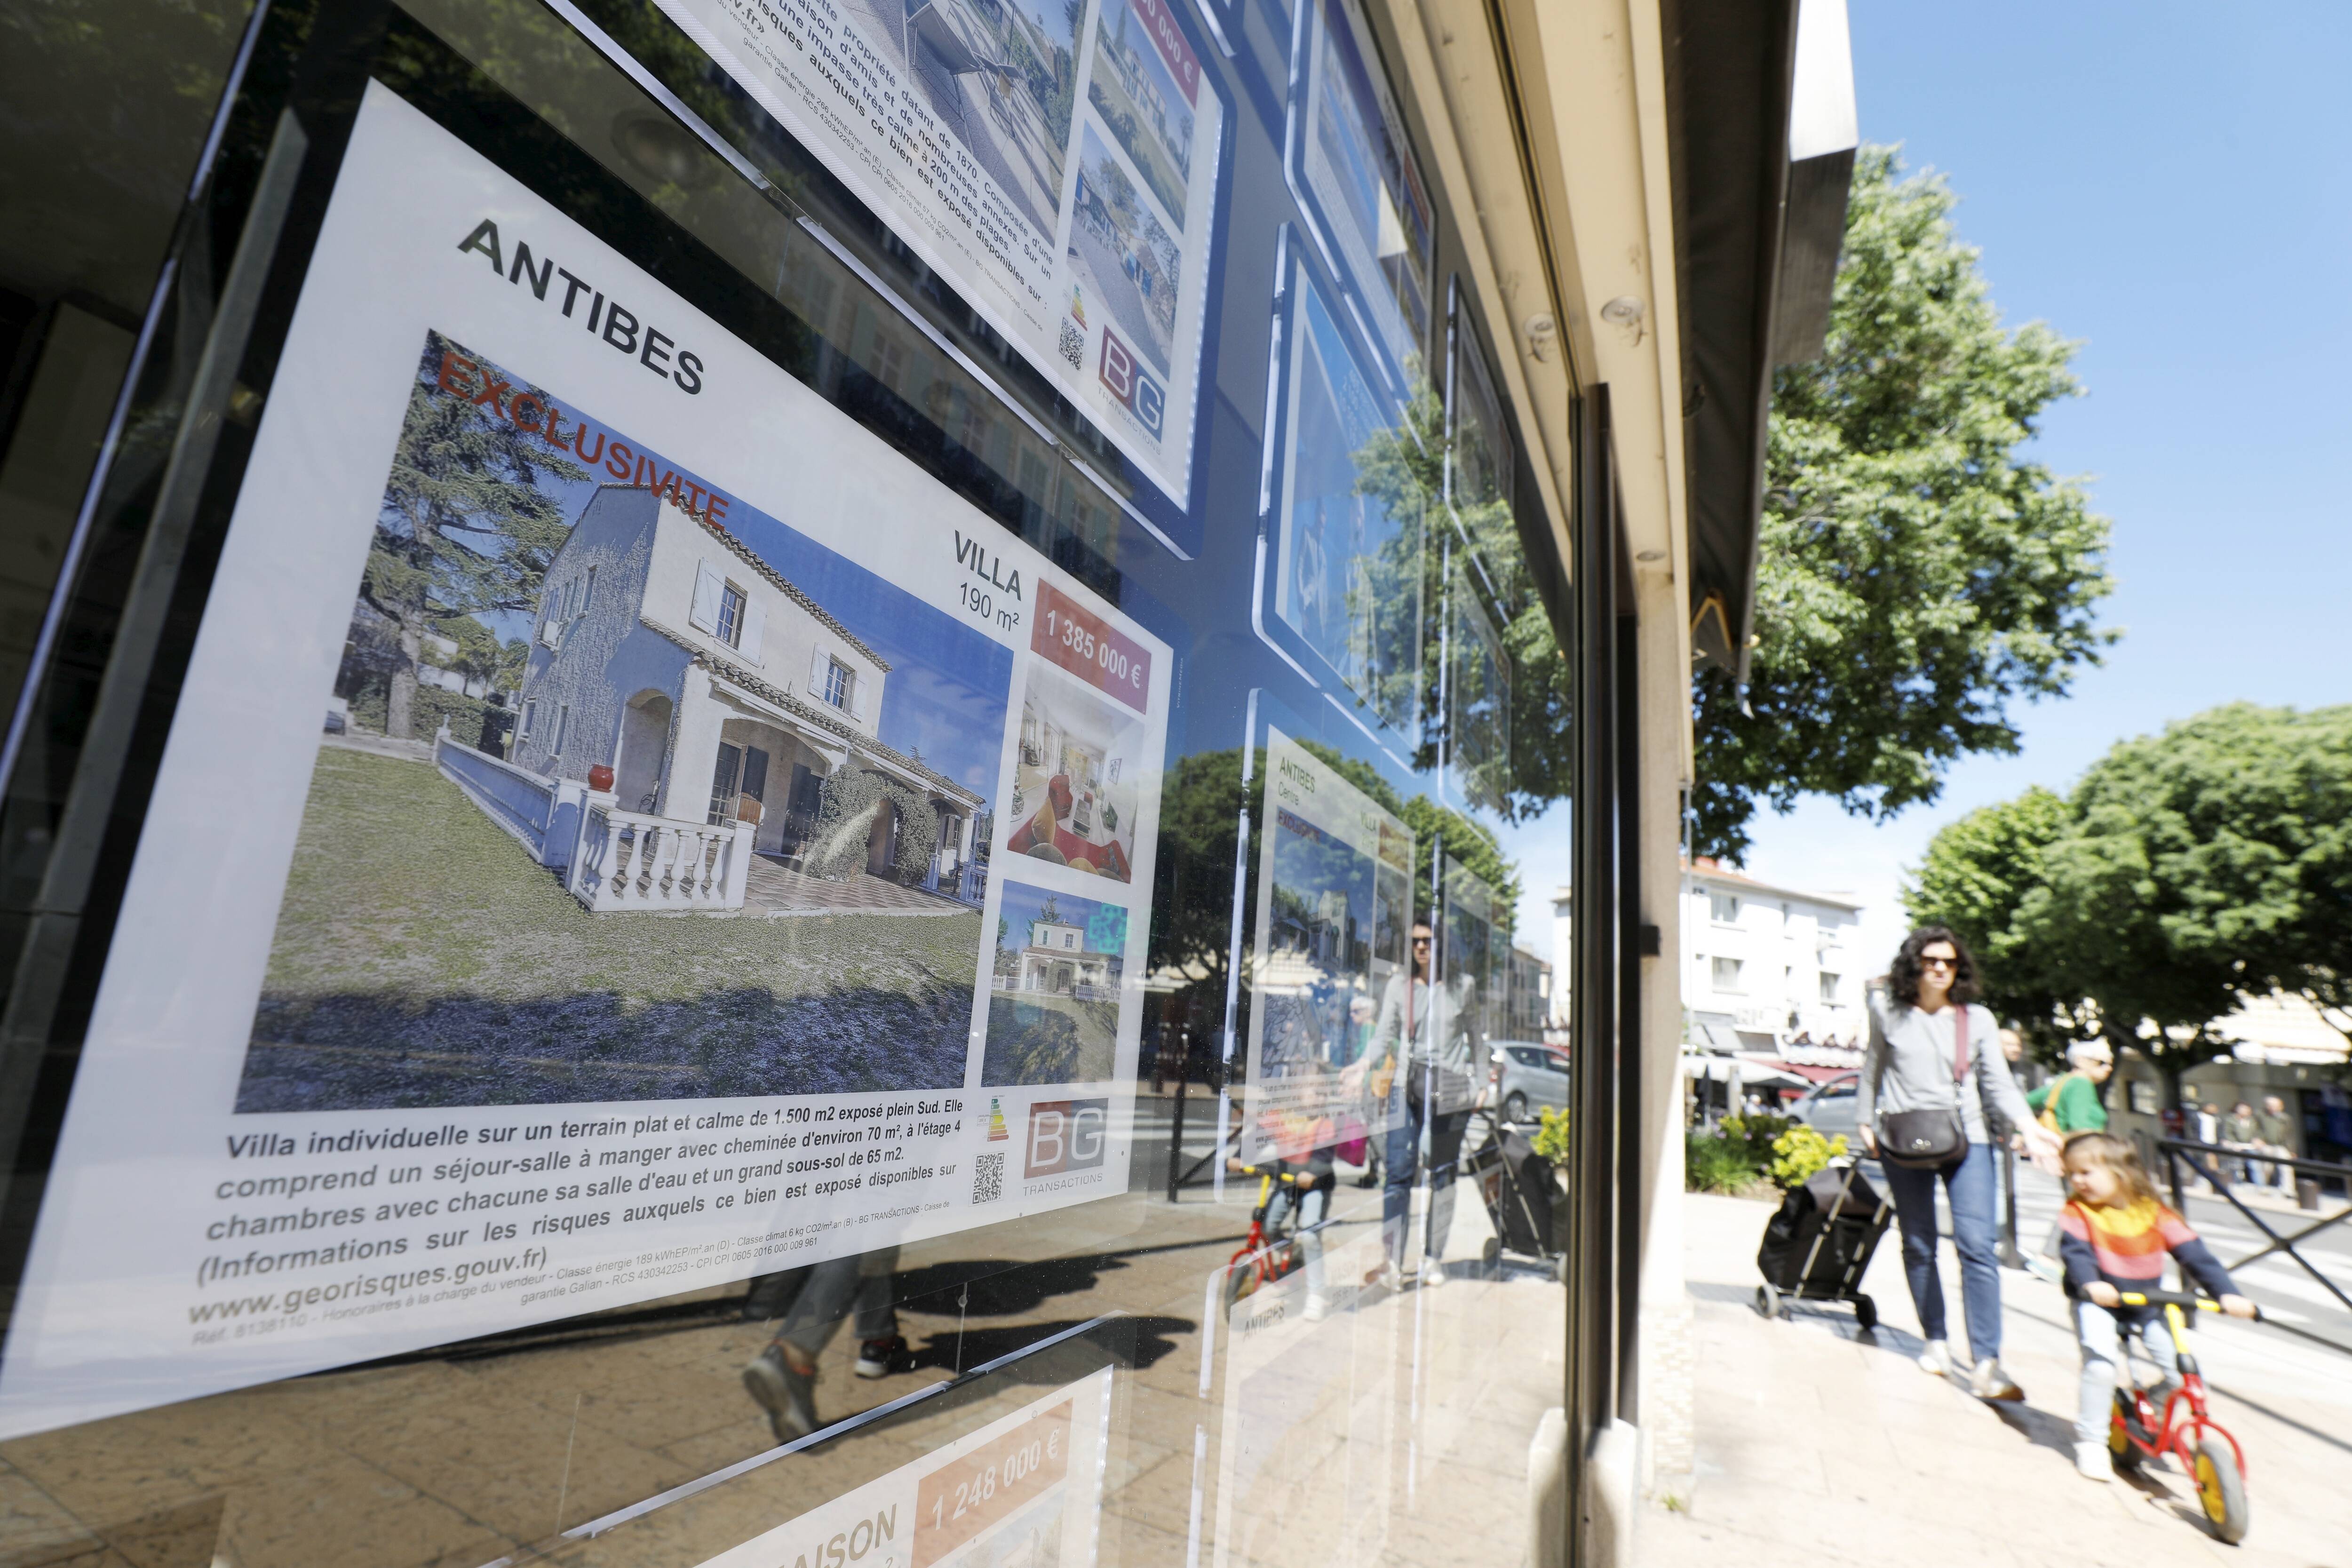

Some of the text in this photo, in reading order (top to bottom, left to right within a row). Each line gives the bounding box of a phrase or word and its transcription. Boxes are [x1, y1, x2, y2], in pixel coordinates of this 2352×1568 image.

[1159, 15, 1192, 83] 000 €
[729, 8, 1020, 309] vendeur Classe énergie 266 Classe climat BG TRANSACTIONS
[743, 37, 913, 209] garantie Galian RCS 430342253 CPI CPI 0605 2016
[807, 26, 859, 88] impasse
[863, 87, 884, 116] très
[888, 116, 918, 153] calme
[922, 150, 928, 163] à
[930, 159, 947, 183] 200
[950, 182, 959, 197] m
[962, 195, 977, 217] des
[980, 215, 1010, 253] plages.
[840, 42, 1051, 279] d'amis et de nombreuses annexes. Sur un
[843, 24, 1052, 265] propriété datant de 1870. Composée d'une
[810, 54, 1041, 302] auxquels ce bien est exposé disponibles sur
[457, 218, 704, 395] ANTIBES
[1097, 385, 1161, 455] TRANSACTIONS
[1104, 336, 1161, 430] BG
[437, 350, 729, 531] EXCLUSIVITE
[955, 529, 1021, 602] VILLA
[960, 582, 1019, 631] 190 m²
[1047, 610, 1141, 689] 1 385 000 €
[1279, 757, 1315, 793] ANTIBES
[1279, 781, 1299, 805] Centre
[215, 1164, 378, 1199] comprend
[389, 1166, 421, 1184] un
[433, 1151, 571, 1184] séjour-salle
[579, 1149, 591, 1168] à
[599, 1146, 672, 1166] manger
[678, 1143, 717, 1159] avec
[724, 1133, 796, 1154] cheminée
[802, 1130, 862, 1147] d'environ
[867, 1126, 881, 1141] 70
[907, 1123, 913, 1138] à
[917, 1122, 951, 1138] l'étage
[954, 1120, 961, 1132] 4
[227, 1099, 963, 1159] Villa individuelle sur un terrain plat et calme de 1.500 m2 exposé plein Sud. Elle
[1031, 1107, 1103, 1168] BG
[206, 1146, 905, 1241] chambres avec chacune sa salle d'eau et un grand sous-sol de 65 m2.
[1023, 1173, 1103, 1196] TRANSACTIONS
[197, 1163, 956, 1289] (Informations sur les risques auxquels ce bien est exposé disponibles sur
[322, 1299, 401, 1322] Honoraires
[434, 1286, 477, 1303] charge
[481, 1282, 496, 1293] du
[500, 1273, 547, 1290] vendeur
[556, 1265, 592, 1281] Classe
[595, 1257, 632, 1272] énergie
[636, 1252, 652, 1265] 189
[717, 1240, 730, 1252] (D)
[737, 1235, 763, 1247] Classe
[765, 1231, 787, 1242] climat
[789, 1228, 794, 1236] 6
[795, 1226, 803, 1237] kg
[843, 1218, 853, 1228] (B)
[859, 1215, 868, 1224] BG
[871, 1206, 919, 1222] TRANSACTIONS
[924, 1203, 942, 1211] Caisse
[189, 1246, 547, 1324] www.georisques.gouv.fr)
[520, 1237, 817, 1305] garantie Galian RCS 430342253 CPI CPI 0605 2016 000 009 961
[932, 1428, 1059, 1530] 1 248 000 €
[779, 1503, 897, 1568] ISON
